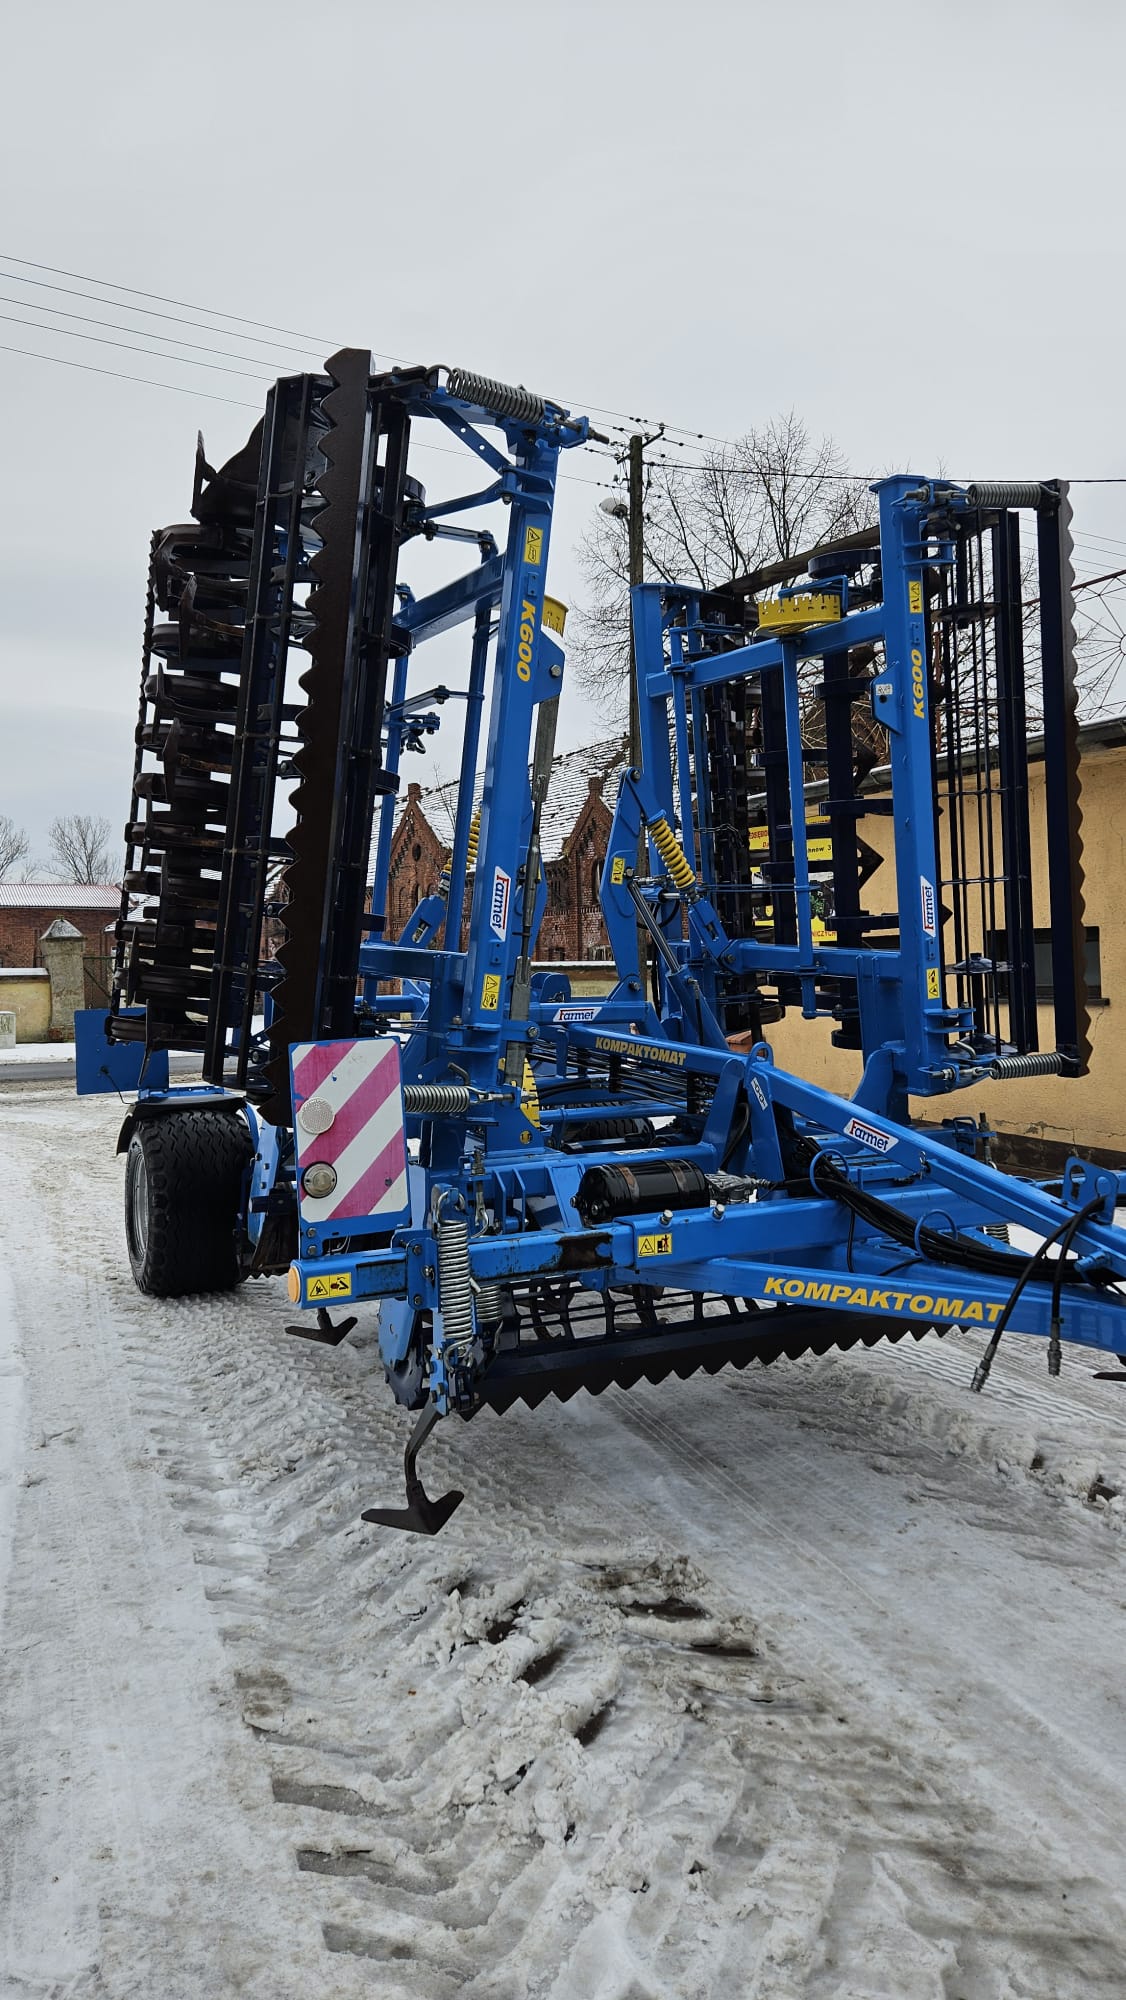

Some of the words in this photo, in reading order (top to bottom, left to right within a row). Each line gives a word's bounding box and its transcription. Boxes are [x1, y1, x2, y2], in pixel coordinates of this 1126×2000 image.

[516, 600, 536, 682] K600
[911, 649, 925, 719] K600
[492, 875, 510, 930] Farmet
[922, 886, 934, 930] Farmet
[559, 1008, 596, 1021] Farmet
[595, 1036, 687, 1066] KOMPAKTOMAT
[849, 1119, 890, 1151] Farmet
[763, 1277, 1007, 1323] KOMPAKTOMAT
